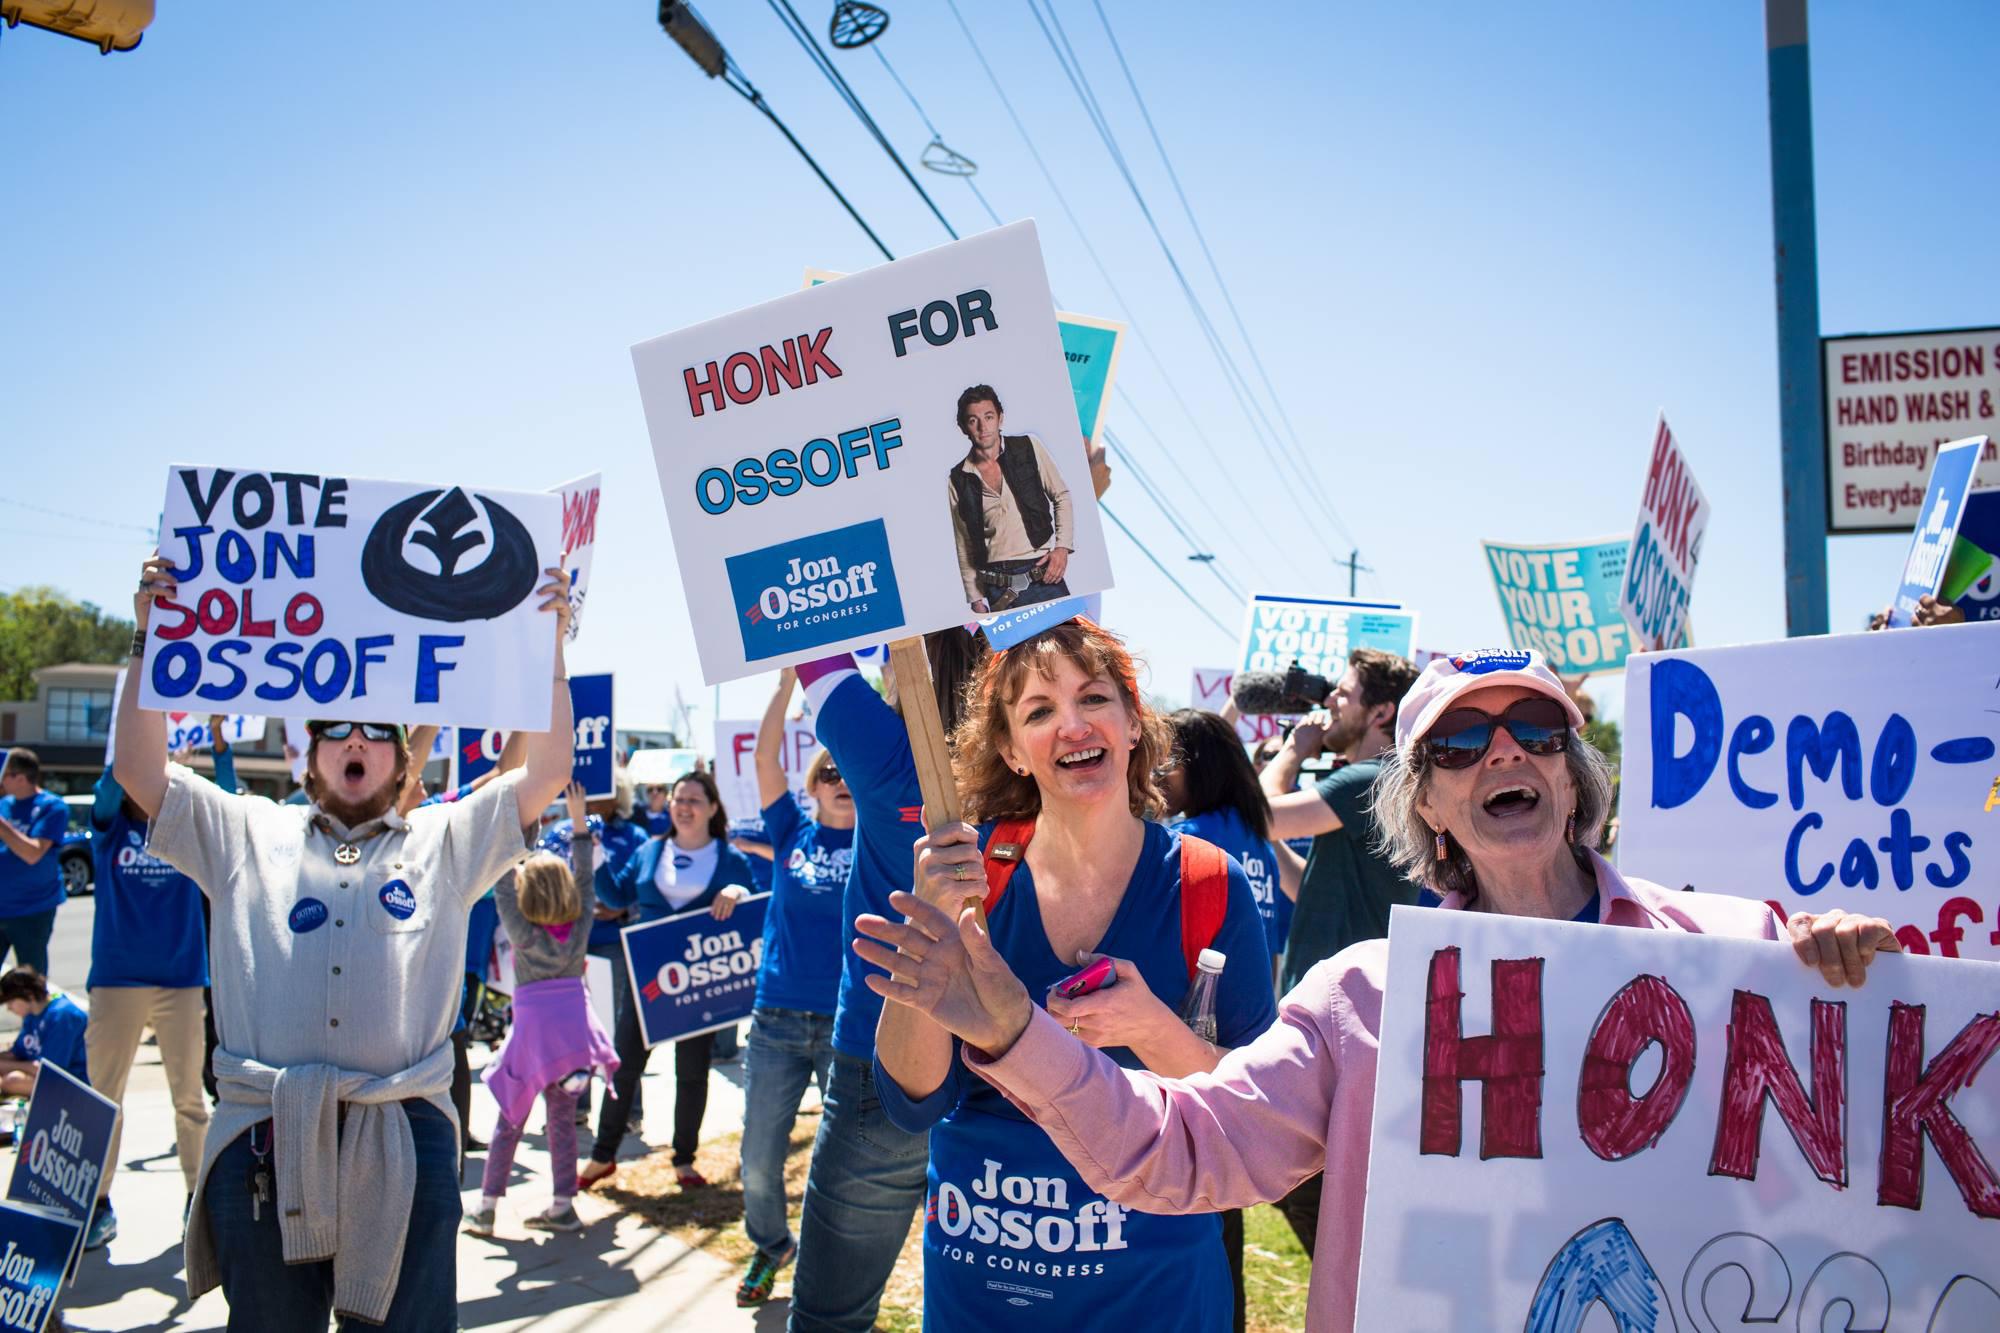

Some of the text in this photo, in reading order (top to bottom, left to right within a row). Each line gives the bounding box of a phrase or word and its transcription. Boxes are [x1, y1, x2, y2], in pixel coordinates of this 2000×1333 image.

[888, 288, 998, 357] FOR
[683, 327, 843, 417] HONK
[1841, 345, 1984, 385] EMISSION
[1837, 389, 1995, 426] HAND WASH &
[696, 418, 903, 516] OSSOFF
[1842, 442, 1928, 470] Birthday
[179, 468, 348, 531] VOTE
[1643, 418, 1699, 576] HONK
[1844, 484, 1927, 514] Everyda
[168, 525, 316, 584] JON
[786, 551, 842, 587] Jon
[1487, 547, 1585, 592] VOTE
[154, 587, 325, 640] SOLO
[758, 560, 879, 621] Ossoff
[1501, 588, 1597, 630] YOUR
[776, 603, 869, 633] FOR CONGRESS
[992, 620, 1013, 635] FOR
[1253, 629, 1349, 657] YOUR
[1256, 606, 1349, 635] VOTE
[1649, 657, 1997, 812] Demo-
[1784, 807, 1973, 897] Cats
[657, 937, 764, 996] Ossof
[684, 930, 745, 963] Jon
[675, 991, 700, 1008] FOR
[1419, 945, 2000, 1219] HONK
[51, 1108, 84, 1160] Jon
[29, 1128, 99, 1210] Ossoff
[972, 1158, 1070, 1211] Jon
[937, 1181, 1134, 1254] Ossoff
[942, 1244, 1105, 1278] FOR CONGRESS
